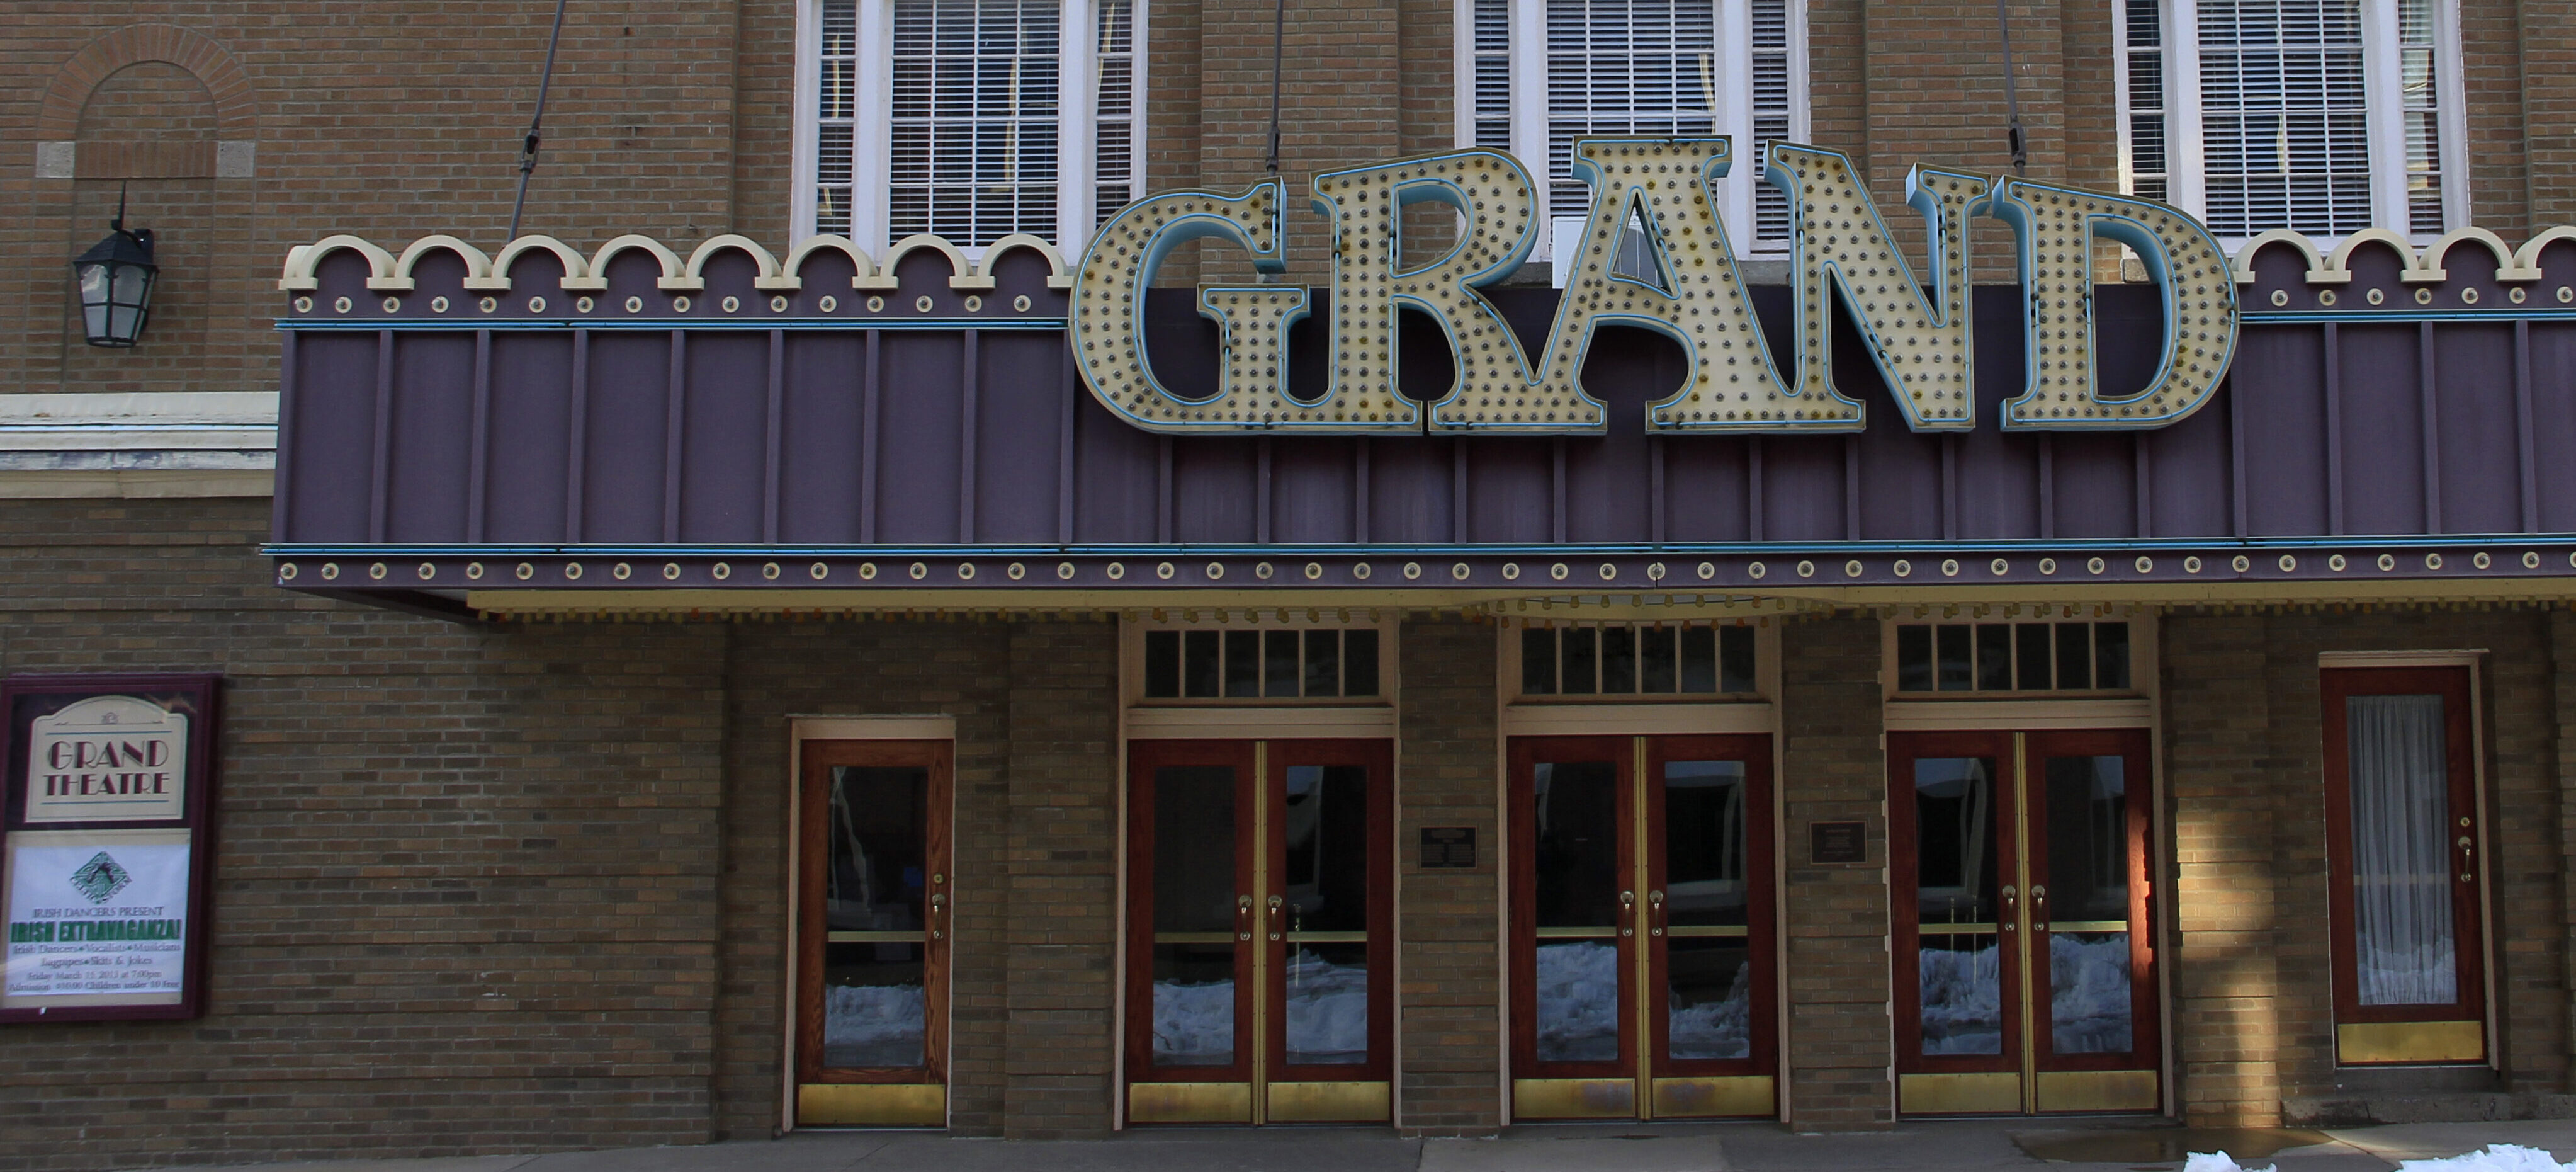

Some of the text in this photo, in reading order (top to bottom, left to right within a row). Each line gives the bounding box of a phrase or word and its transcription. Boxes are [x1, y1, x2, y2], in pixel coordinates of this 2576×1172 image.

[1069, 134, 2241, 436] GRAND
[48, 739, 169, 770] GRAND
[43, 772, 170, 796] THEATRE
[33, 906, 164, 918] IRISH DANCERS PRESENT
[11, 919, 181, 942] IRISH EXTRAVAGANZA!
[14, 945, 35, 954] Irish
[116, 956, 124, 965] &
[128, 955, 152, 967] Jokes
[28, 972, 52, 982] Friday
[55, 971, 82, 979] March
[99, 970, 119, 979] 2013
[9, 983, 51, 991] Admission
[84, 981, 121, 990] Children
